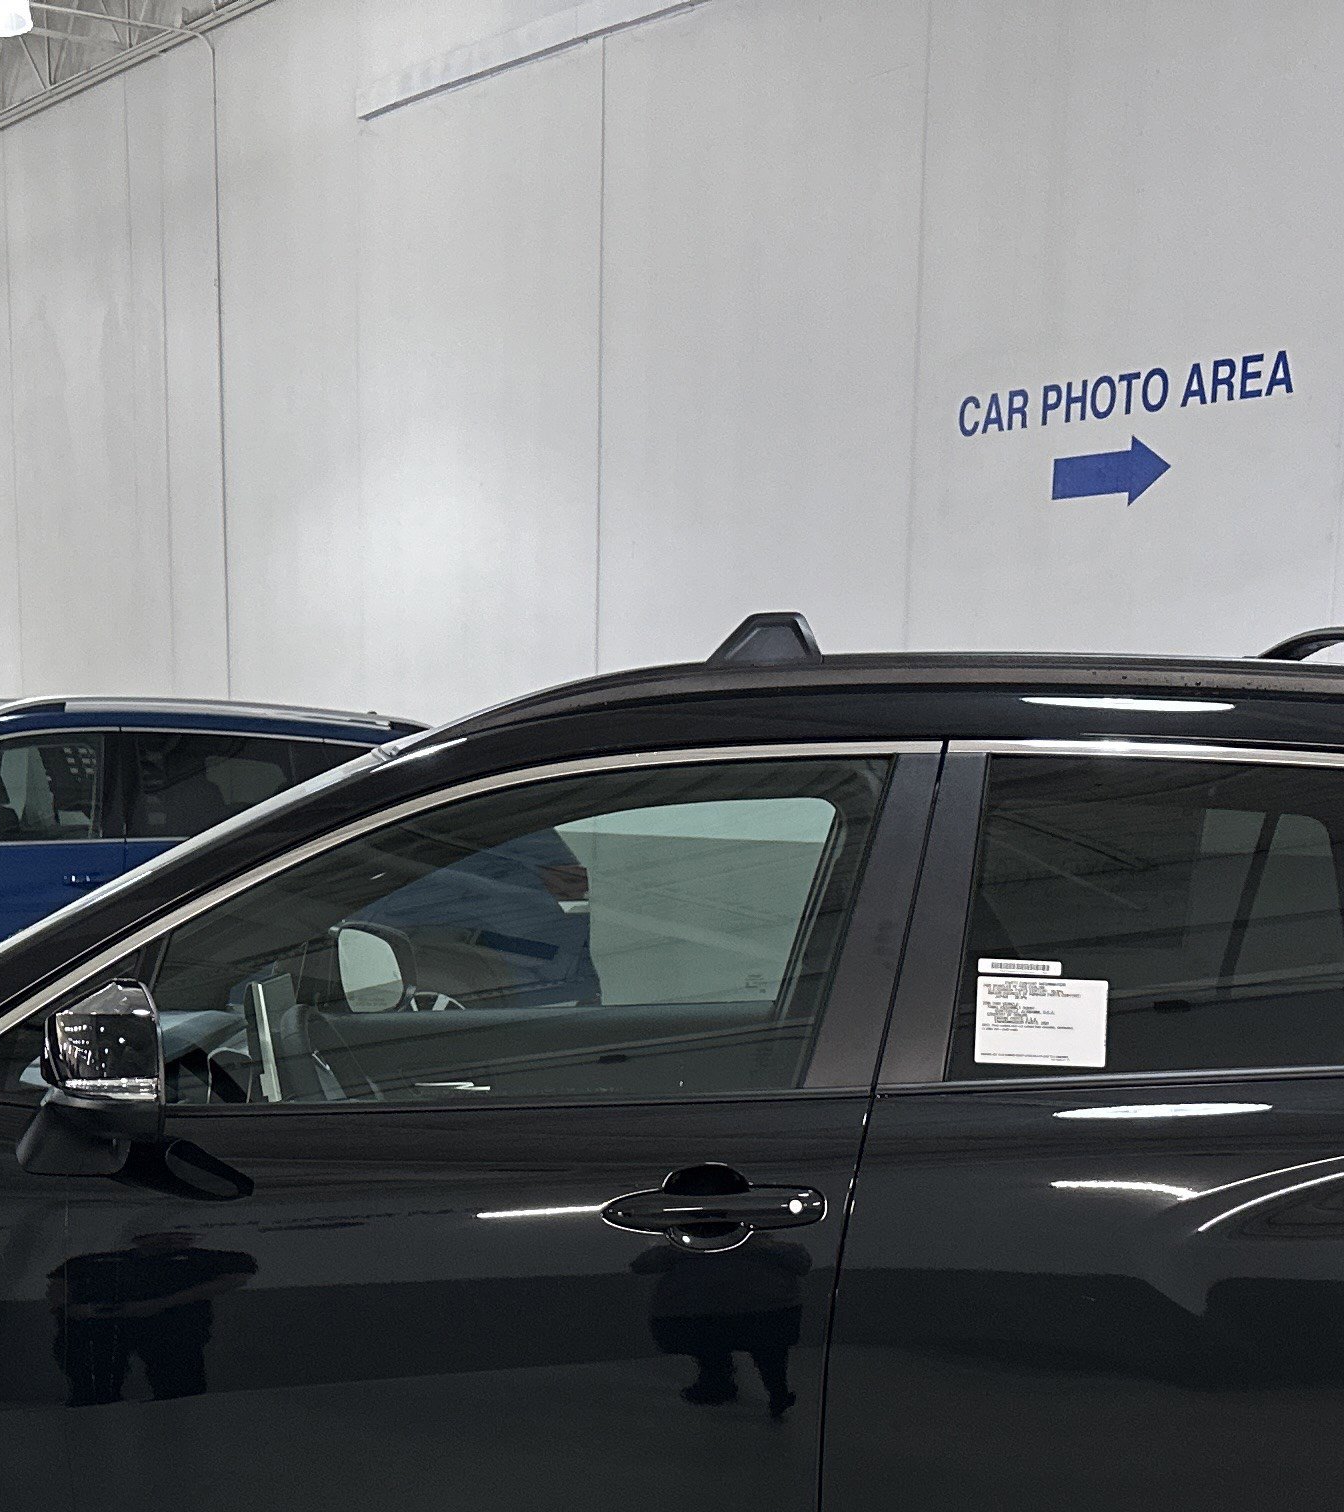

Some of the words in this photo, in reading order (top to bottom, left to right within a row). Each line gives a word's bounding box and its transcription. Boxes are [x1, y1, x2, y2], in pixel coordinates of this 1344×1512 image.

[958, 389, 1029, 437] CAR
[1041, 367, 1170, 426] PHOTO
[1180, 349, 1294, 408] AREA
